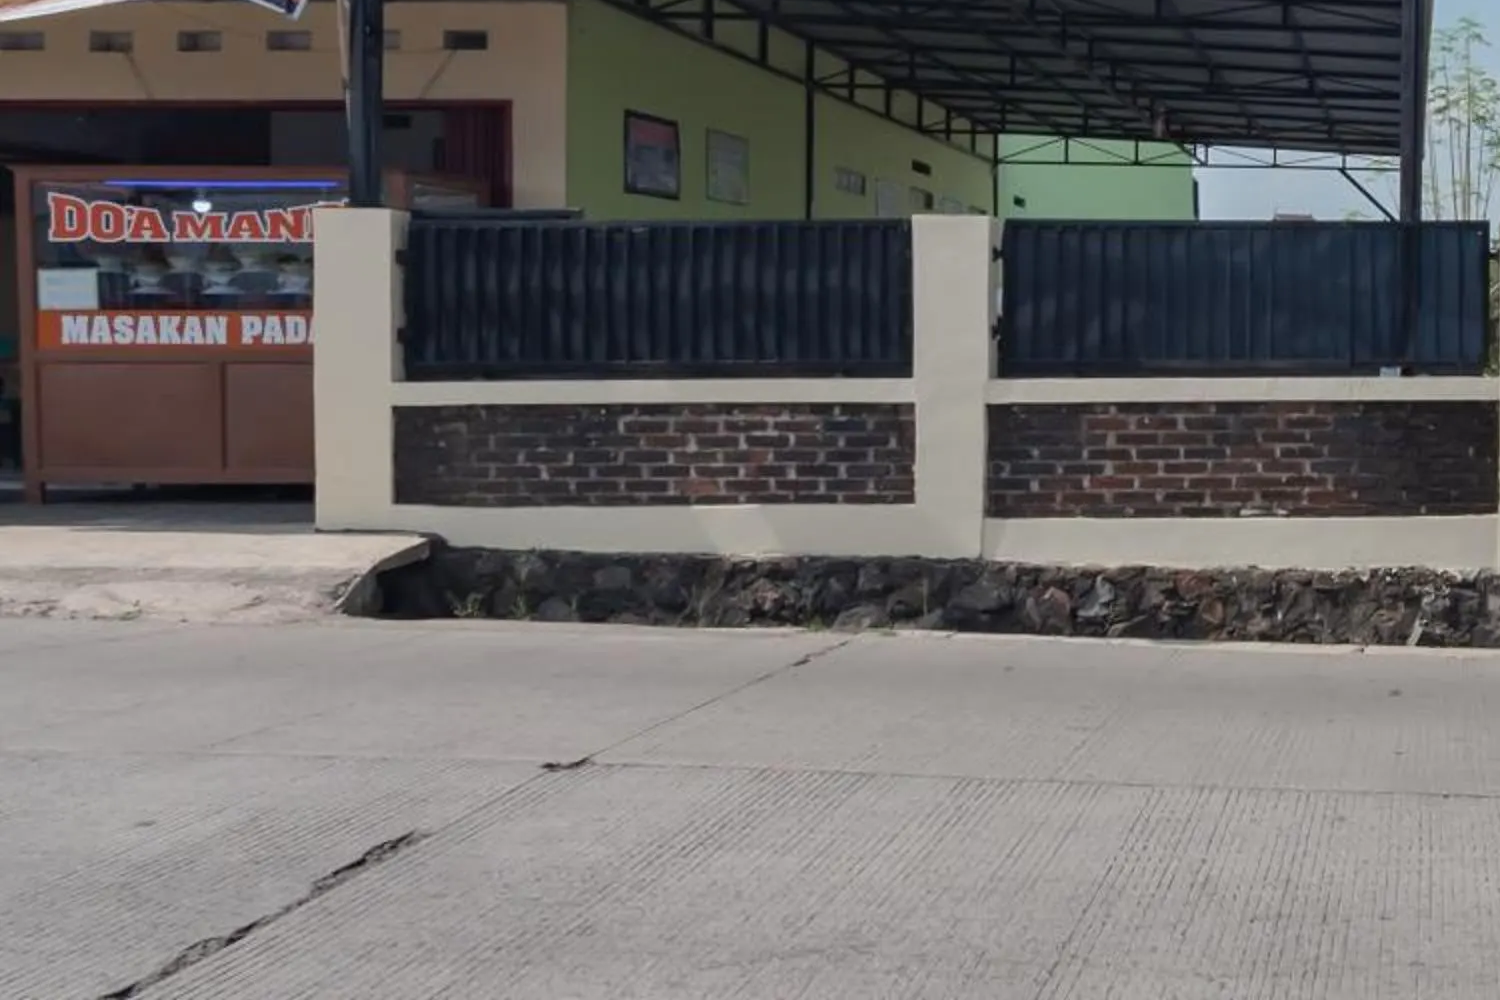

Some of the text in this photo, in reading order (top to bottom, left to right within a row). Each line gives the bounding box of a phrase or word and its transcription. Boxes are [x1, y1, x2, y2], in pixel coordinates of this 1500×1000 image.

[173, 203, 314, 242] MAN
[61, 314, 315, 345] MASAKAN PAD
